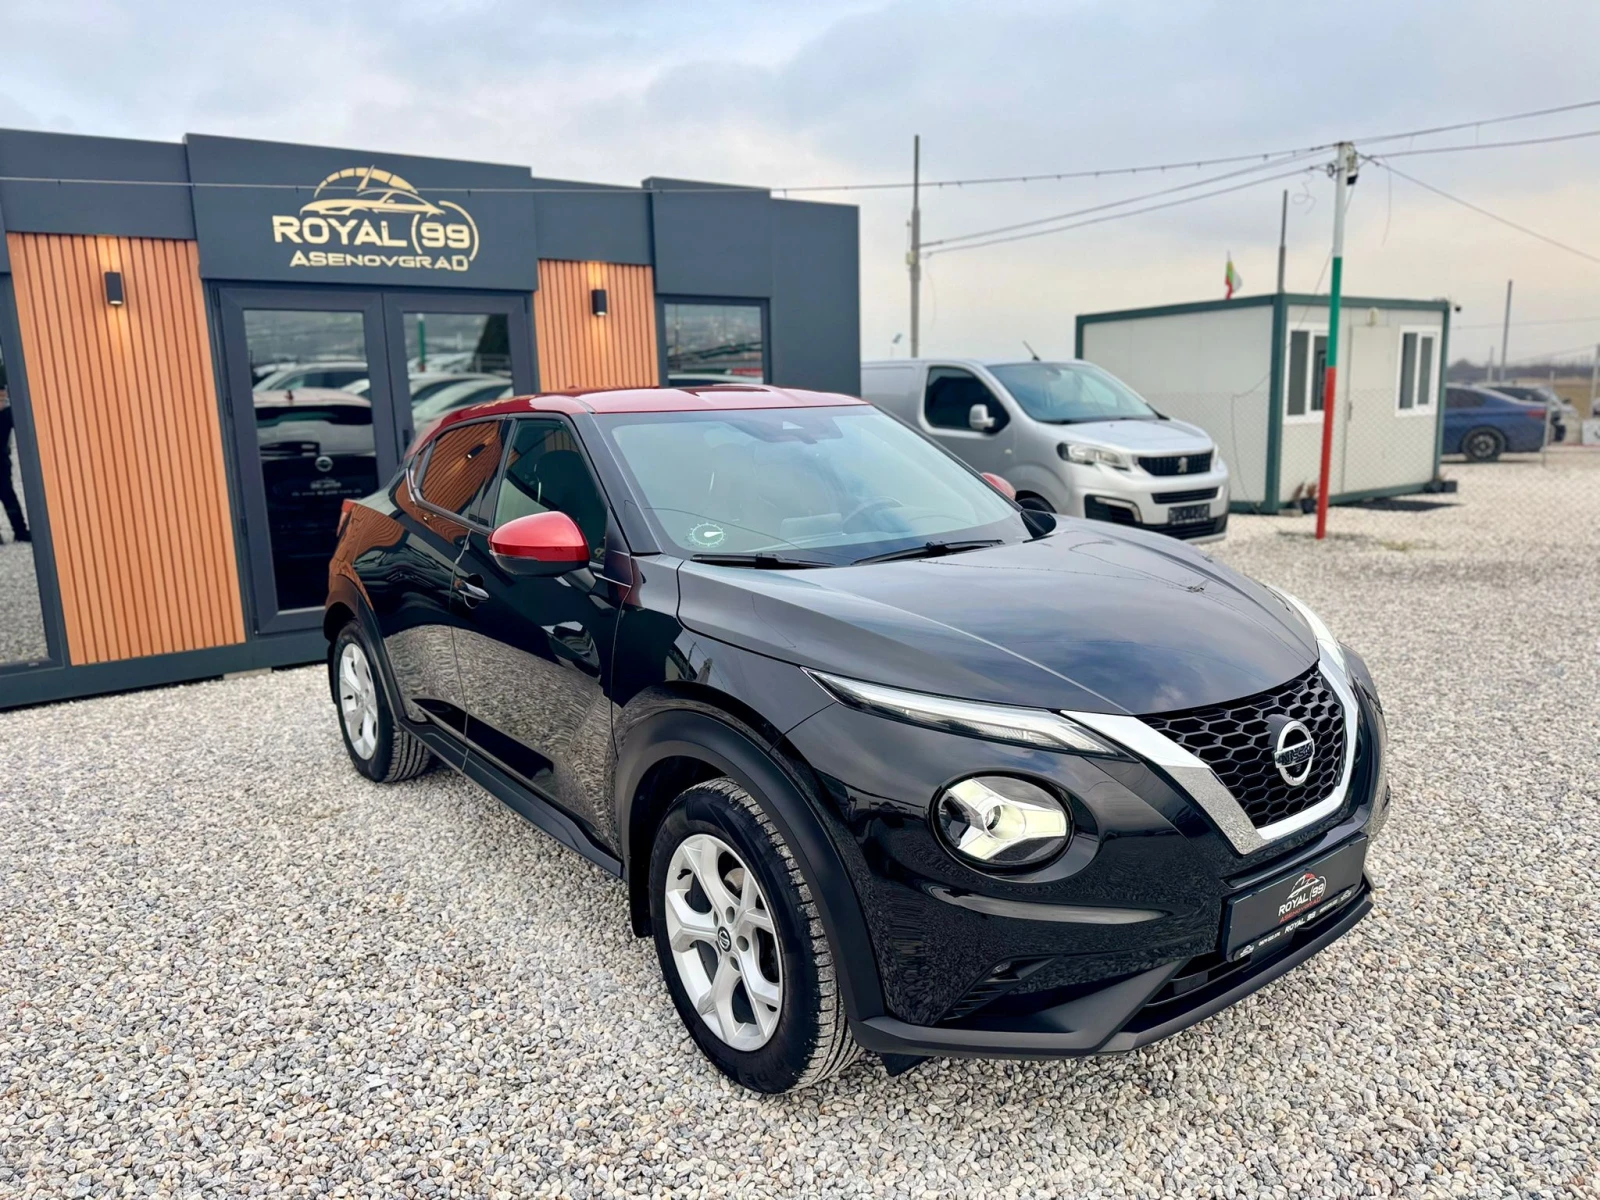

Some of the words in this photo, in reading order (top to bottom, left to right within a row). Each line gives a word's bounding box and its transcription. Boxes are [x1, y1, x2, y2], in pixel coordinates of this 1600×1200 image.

[272, 215, 408, 248] ROYAL
[289, 250, 469, 272] ASENOVGRAD
[1278, 892, 1309, 917] ROYAL
